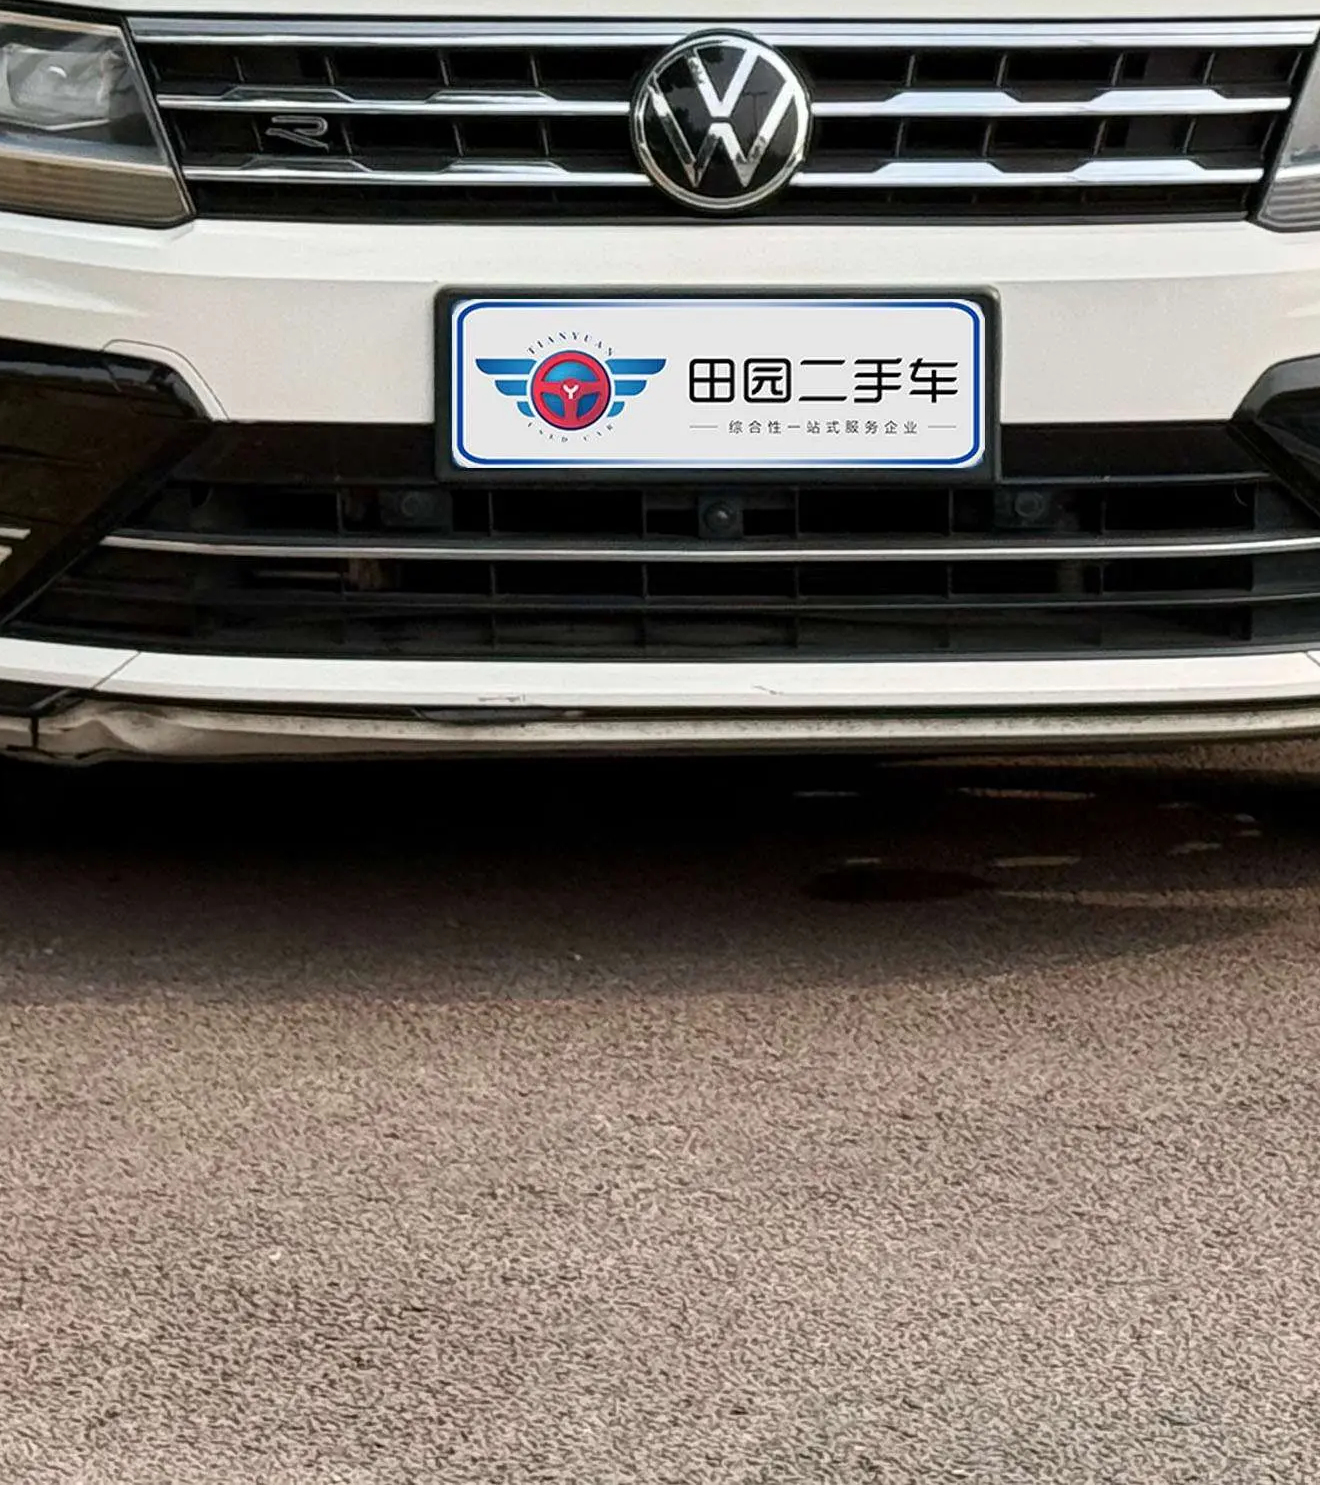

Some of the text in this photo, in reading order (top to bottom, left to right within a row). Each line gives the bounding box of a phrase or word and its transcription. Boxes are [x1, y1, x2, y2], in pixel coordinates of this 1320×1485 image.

[689, 357, 959, 404] 田园二手车
[728, 419, 919, 435] 综合性一站式服务企业
